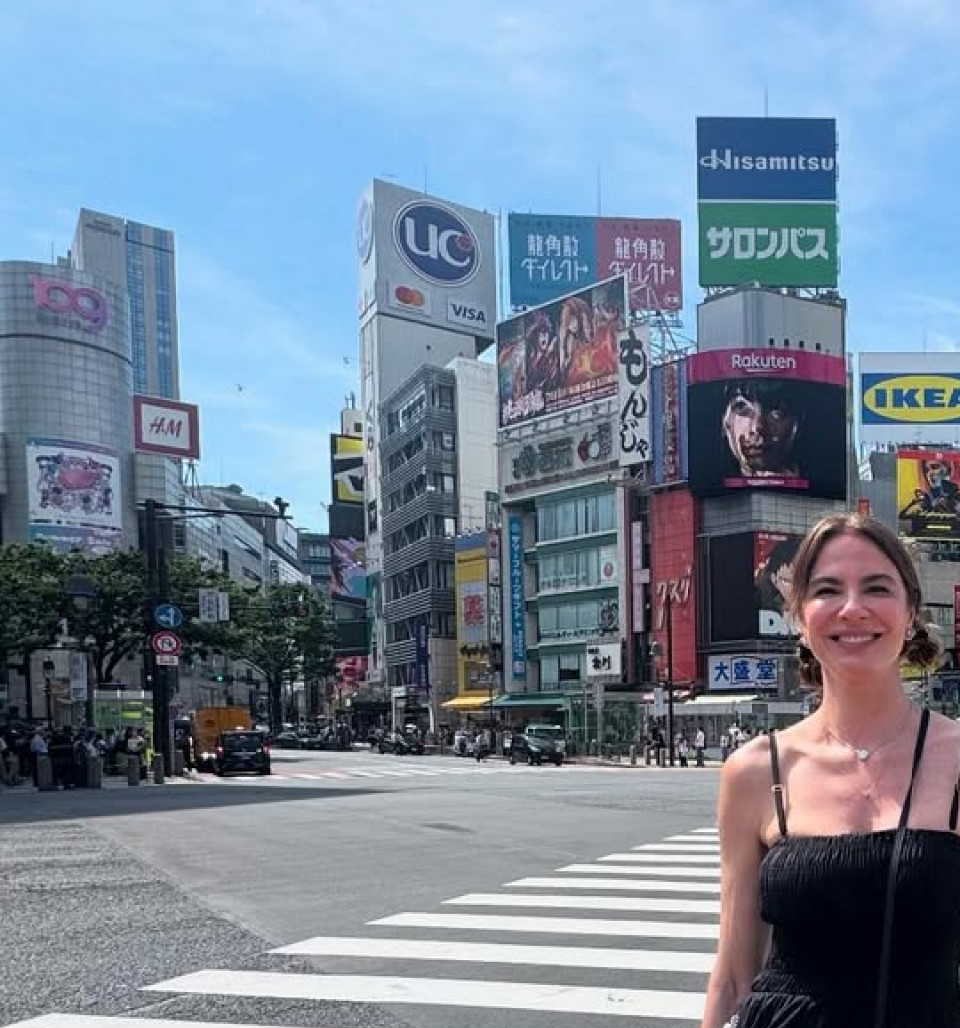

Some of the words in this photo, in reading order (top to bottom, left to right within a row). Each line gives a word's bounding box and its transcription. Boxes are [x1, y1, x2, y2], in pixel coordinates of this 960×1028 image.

[699, 149, 834, 171] Hisamitsu
[403, 216, 471, 269] UC
[706, 226, 829, 260] サロンパス
[453, 303, 486, 324] VISA
[731, 353, 796, 369] Rakuten
[619, 331, 651, 459] もんじゃ
[149, 416, 182, 438] H&M
[714, 658, 776, 682] 大盛堂
